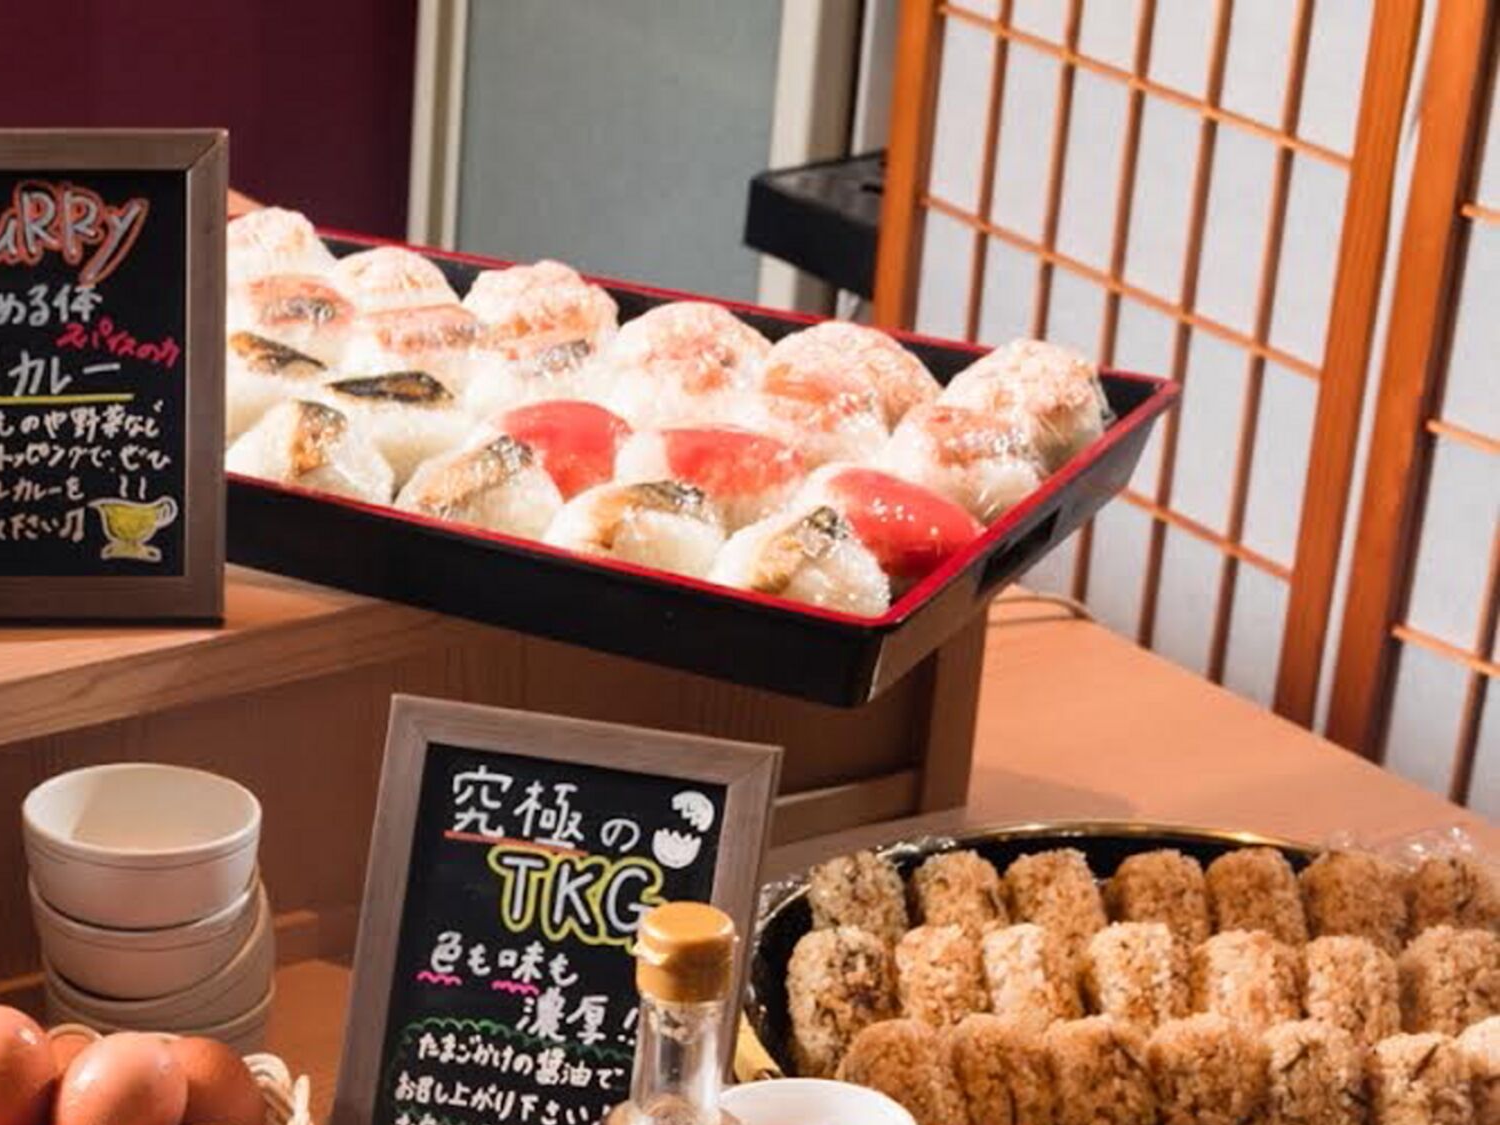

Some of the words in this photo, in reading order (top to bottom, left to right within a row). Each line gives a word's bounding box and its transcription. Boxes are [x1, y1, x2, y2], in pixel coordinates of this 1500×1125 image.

[453, 764, 641, 852] 究極の
[492, 850, 660, 945] TKG
[430, 931, 578, 987] 色も味も
